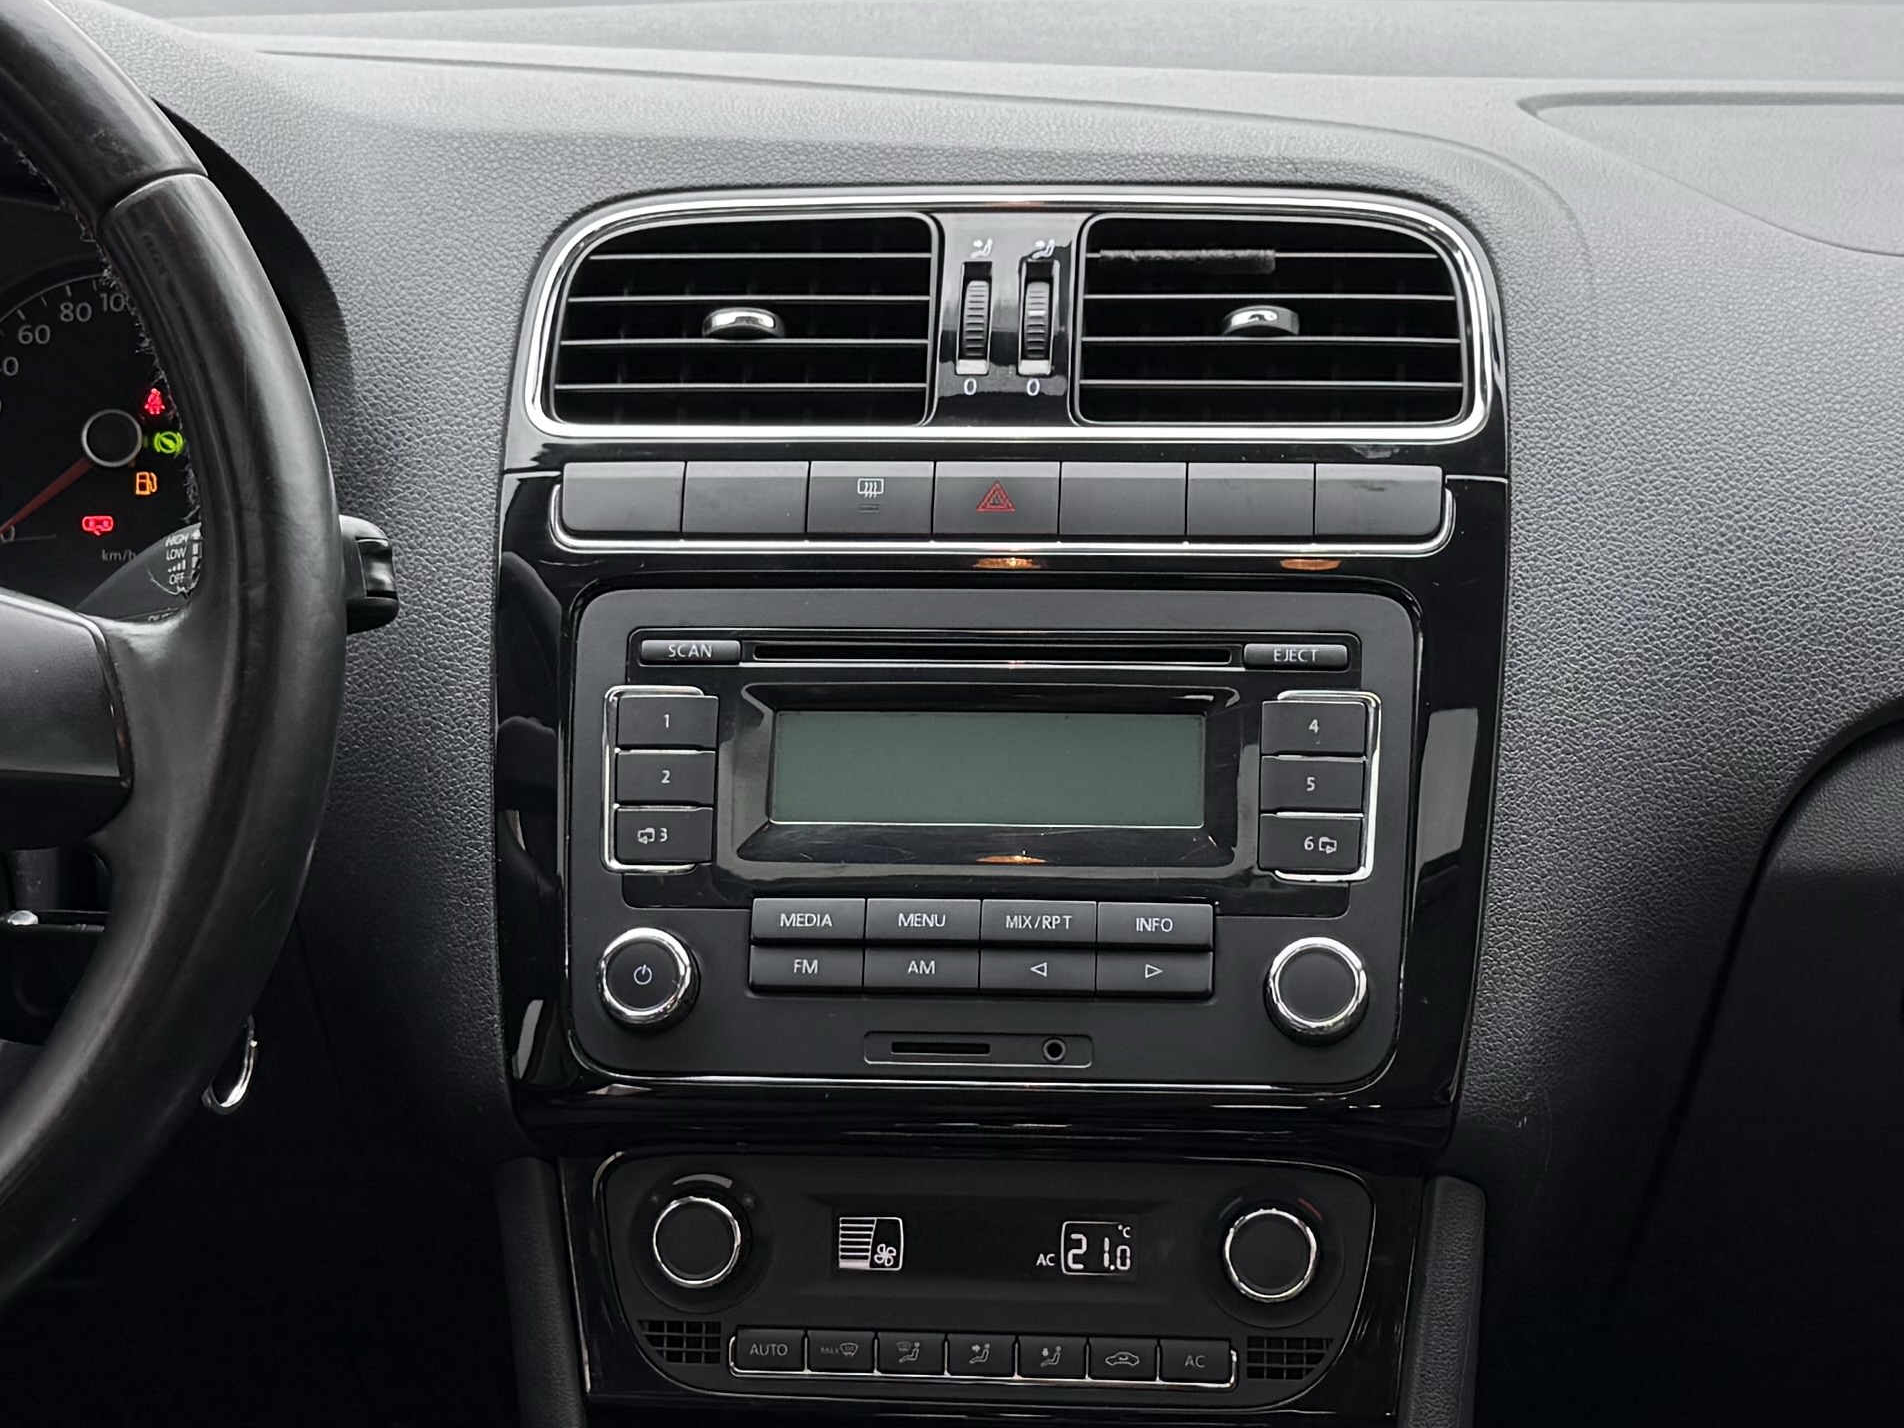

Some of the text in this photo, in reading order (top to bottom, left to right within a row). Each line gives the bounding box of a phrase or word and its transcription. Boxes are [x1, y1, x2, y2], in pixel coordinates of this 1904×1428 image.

[98, 292, 127, 312] 10
[59, 301, 93, 322] 80
[17, 324, 51, 345] 60
[101, 548, 137, 562] km/h
[166, 547, 188, 561] LOW
[169, 571, 186, 585] OFF
[668, 644, 713, 659] SCAN
[1273, 648, 1320, 663] EJECT
[663, 713, 670, 729] 1
[1308, 719, 1320, 734] 4
[661, 770, 671, 784] 2
[1306, 776, 1316, 791] 5
[659, 827, 669, 841] 3
[1303, 836, 1315, 851] 6
[779, 913, 833, 929] MEDIA
[897, 913, 947, 929] MENU
[1005, 915, 1073, 931] MIX/RPT
[1135, 917, 1174, 933] INFO
[793, 959, 819, 975] FM
[907, 959, 936, 975] AM
[1036, 1253, 1056, 1266] AC
[1067, 1233, 1131, 1270] 21.0
[749, 1343, 788, 1356] AUTO
[1184, 1353, 1207, 1368] AC
